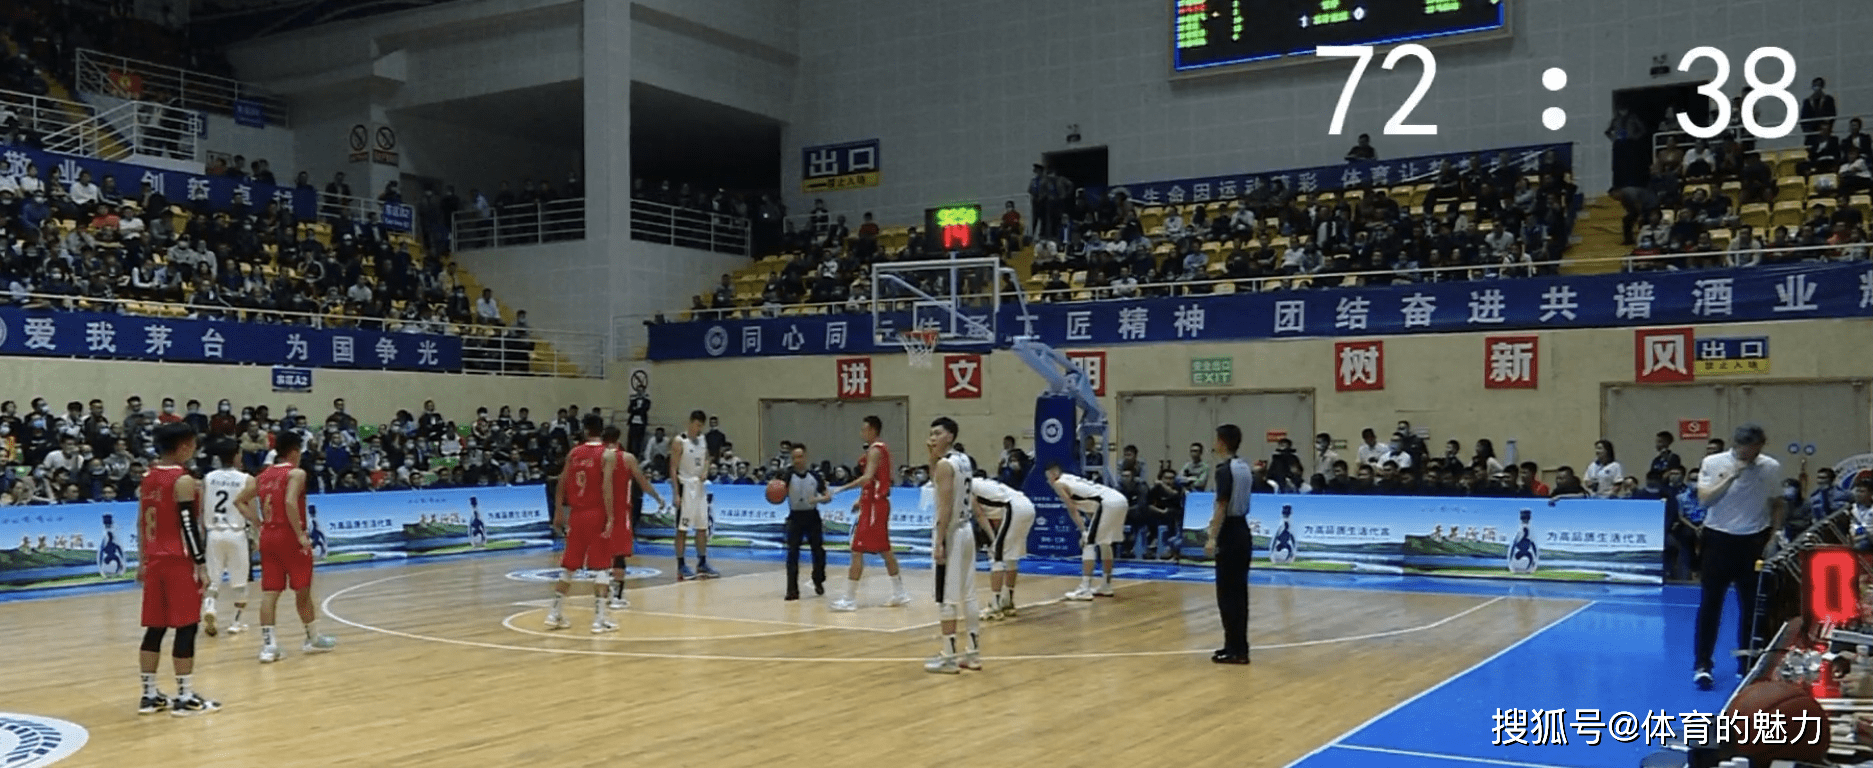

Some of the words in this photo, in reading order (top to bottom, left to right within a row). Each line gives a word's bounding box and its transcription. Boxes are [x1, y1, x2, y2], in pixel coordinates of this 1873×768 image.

[808, 147, 875, 177] 出口
[1142, 171, 1318, 204] 生命因运动彩
[24, 317, 225, 358] 爱我茅台
[286, 333, 439, 366] 为国争光
[1701, 340, 1763, 359] 出口
[841, 362, 868, 395] 讲
[948, 359, 979, 393] 文
[1339, 345, 1380, 386] 树
[1489, 342, 1534, 383] 新
[1642, 334, 1688, 377] 风
[1192, 372, 1232, 384] EXIT
[575, 470, 587, 498] 9
[214, 490, 229, 515] 2
[1811, 552, 1858, 623] 0
